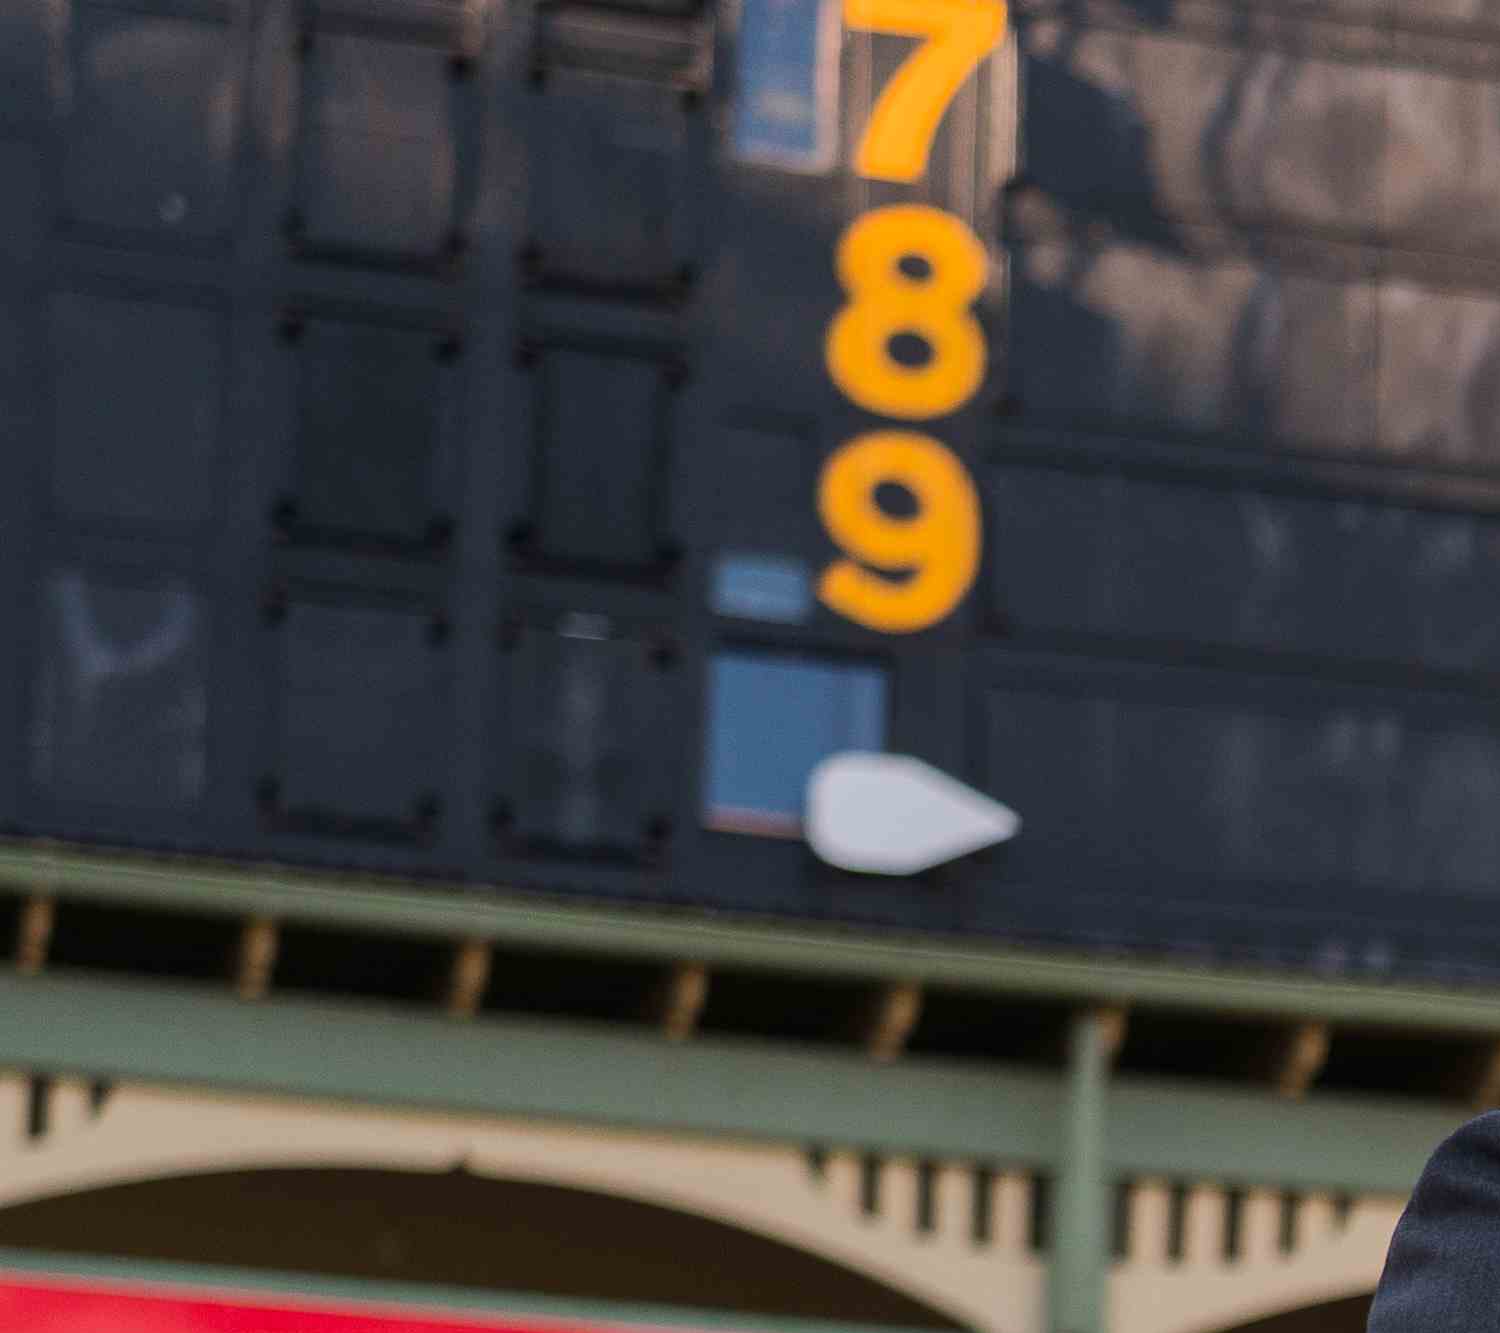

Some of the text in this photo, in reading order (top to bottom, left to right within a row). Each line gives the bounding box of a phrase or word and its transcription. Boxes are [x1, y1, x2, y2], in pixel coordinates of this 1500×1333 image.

[839, 0, 1009, 183] 7
[825, 204, 989, 420] 8
[816, 429, 982, 633] 9
